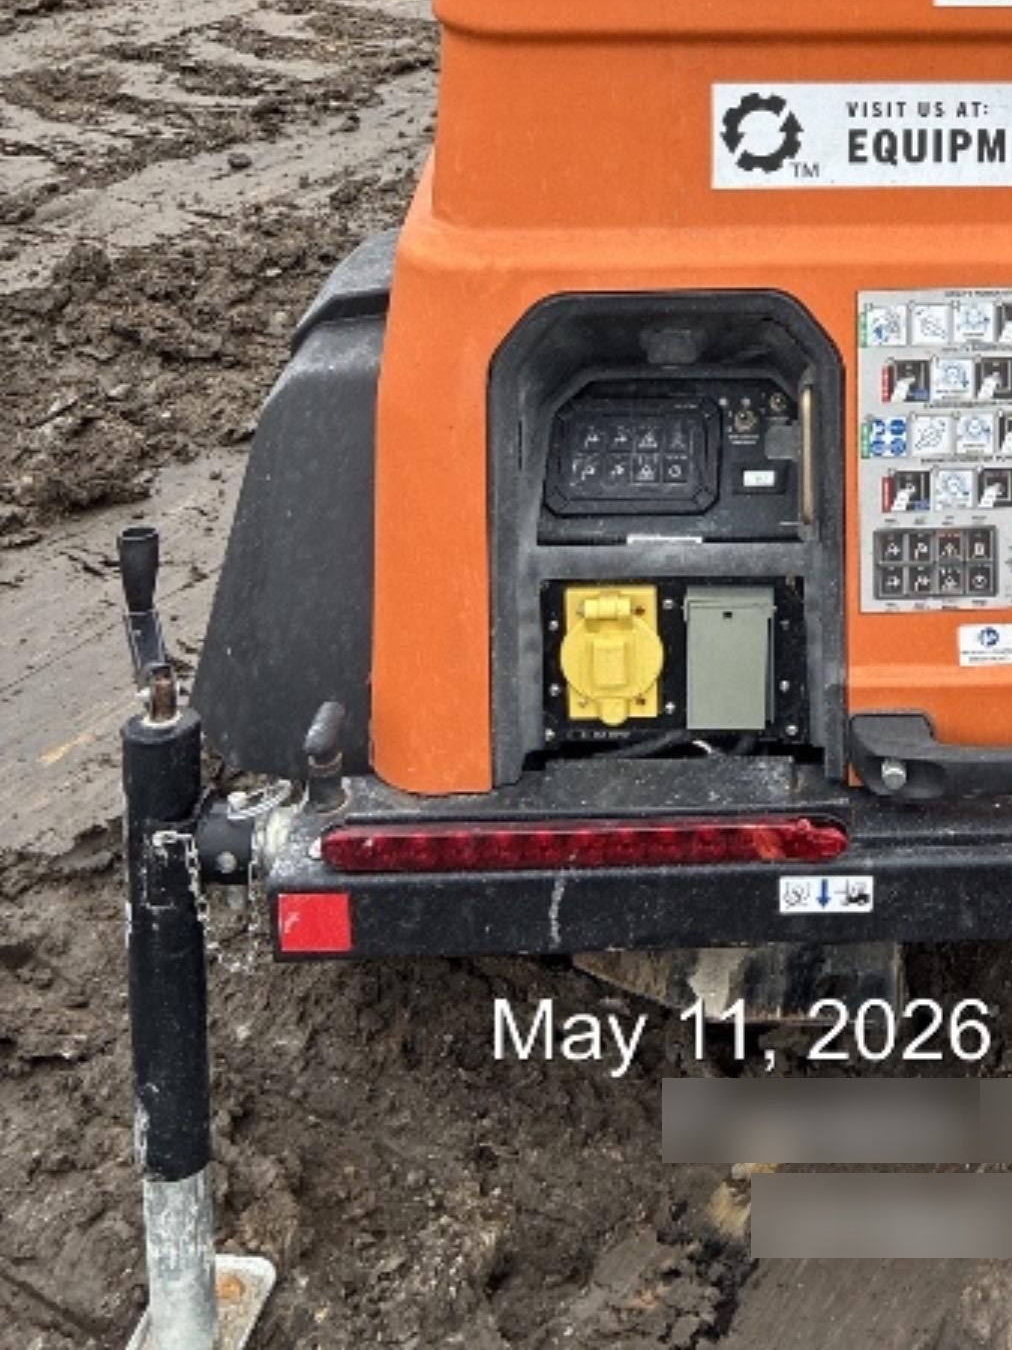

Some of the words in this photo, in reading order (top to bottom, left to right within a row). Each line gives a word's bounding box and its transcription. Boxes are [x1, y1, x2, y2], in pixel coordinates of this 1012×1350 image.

[847, 101, 907, 118] VISIT
[918, 101, 944, 118] US
[956, 101, 989, 118] AT:
